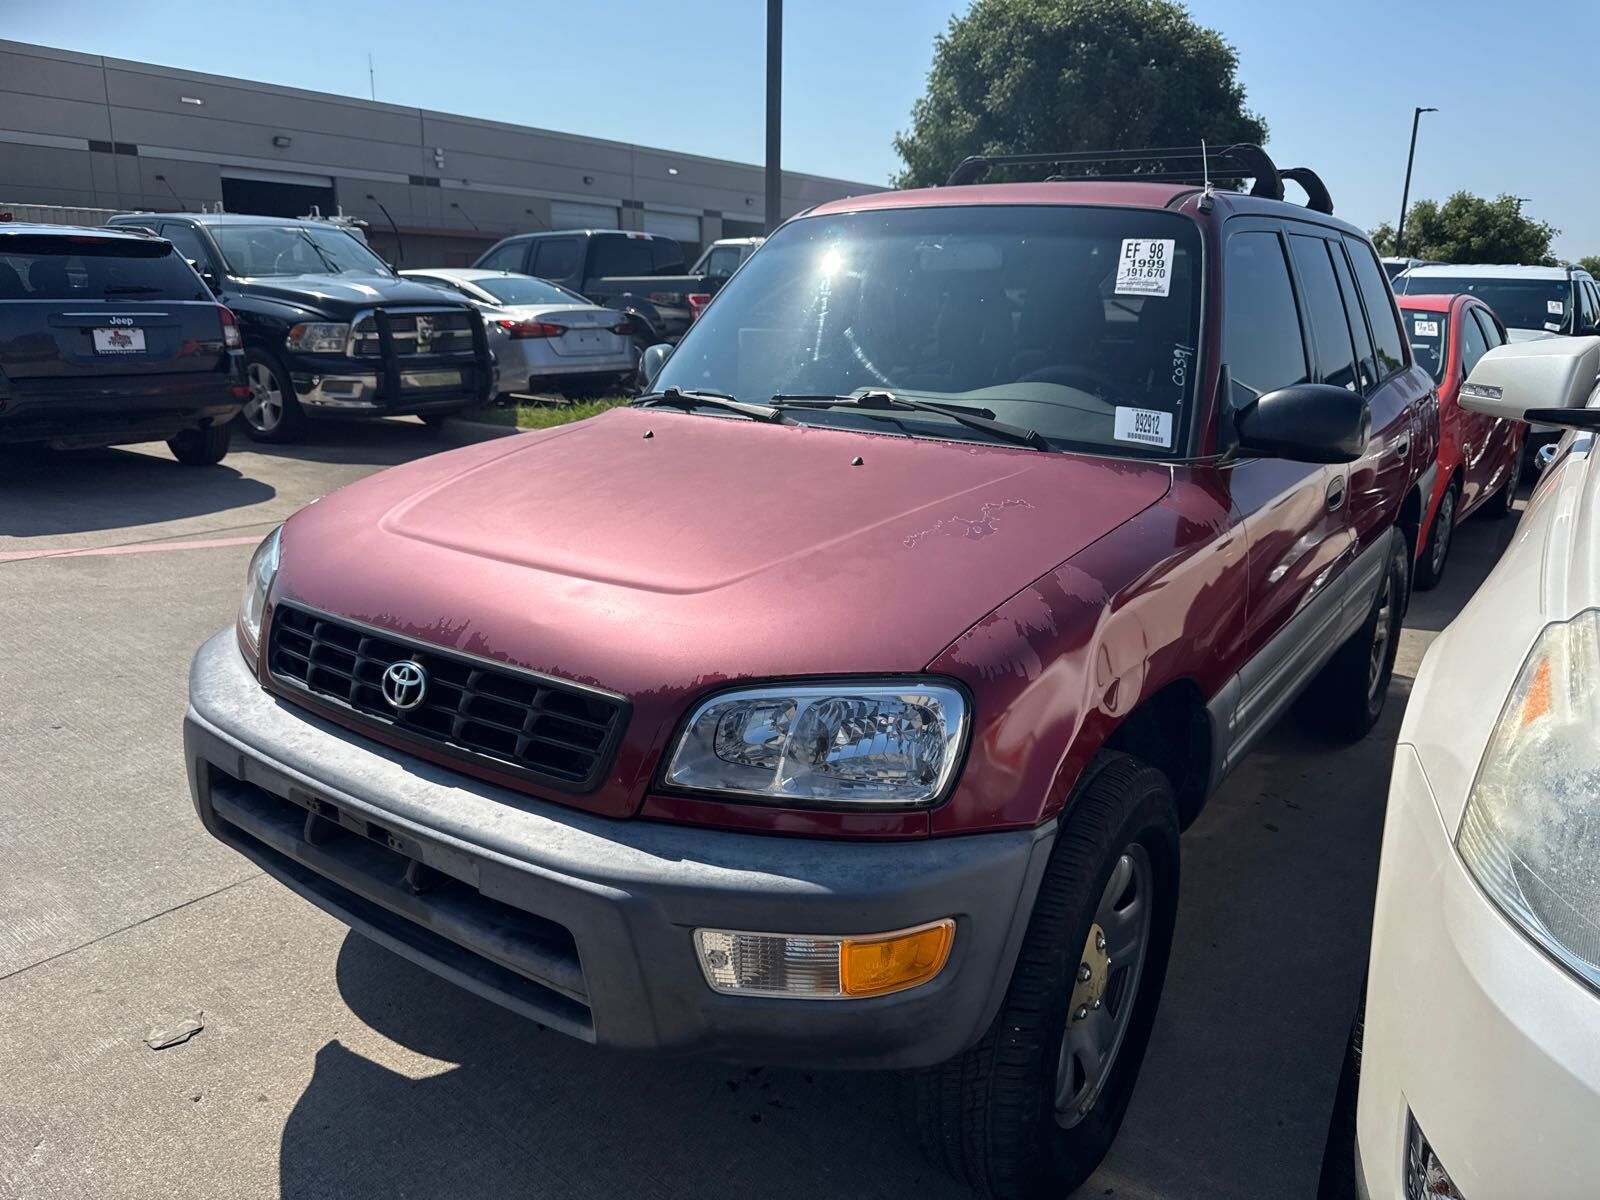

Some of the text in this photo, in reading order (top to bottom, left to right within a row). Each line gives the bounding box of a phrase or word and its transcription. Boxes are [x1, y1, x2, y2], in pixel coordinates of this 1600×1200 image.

[1125, 242, 1165, 260] EF 98
[1130, 258, 1165, 269] 1999
[1125, 267, 1166, 279] 191,670
[109, 316, 134, 326] Jeep
[1135, 412, 1160, 435] 892912
